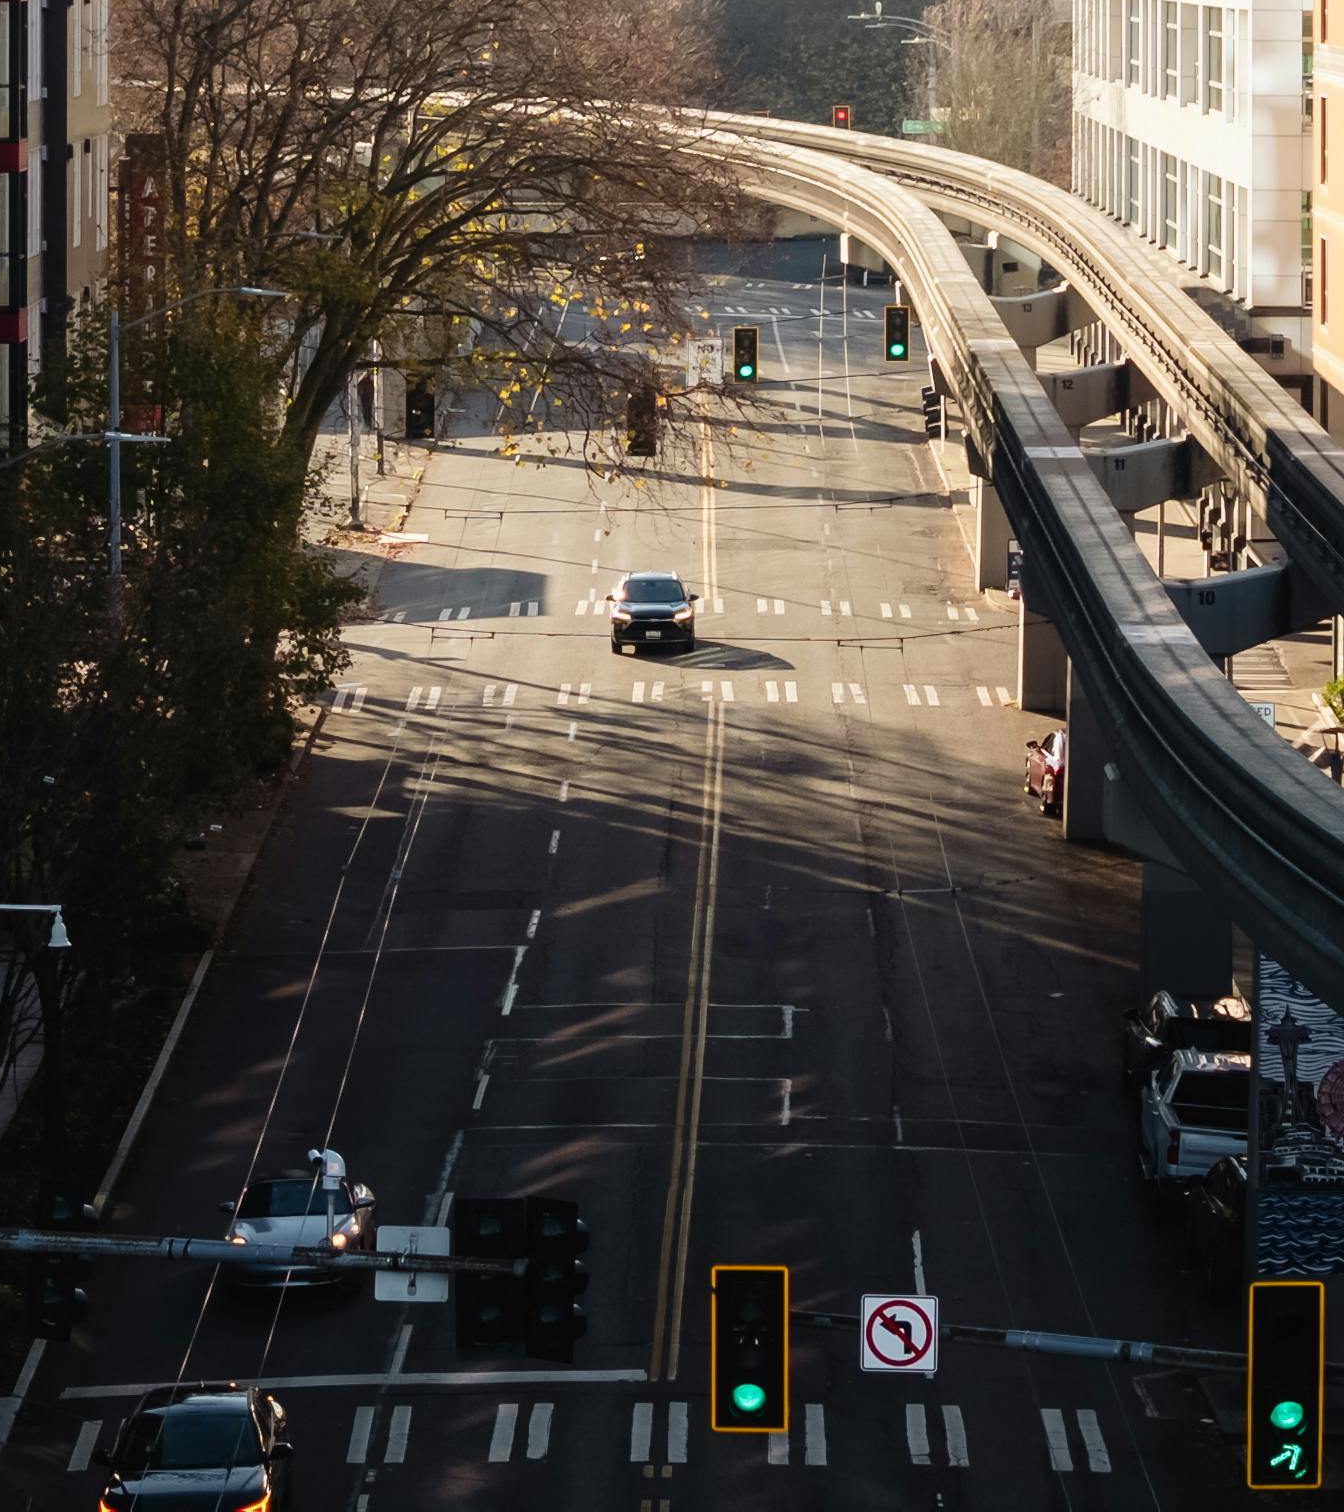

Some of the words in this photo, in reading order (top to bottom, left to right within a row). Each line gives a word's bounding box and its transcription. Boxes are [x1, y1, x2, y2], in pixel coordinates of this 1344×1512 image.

[1022, 303, 1033, 313] 13
[1062, 378, 1074, 390] 12
[1114, 458, 1126, 471] 11
[1197, 590, 1216, 606] 10
